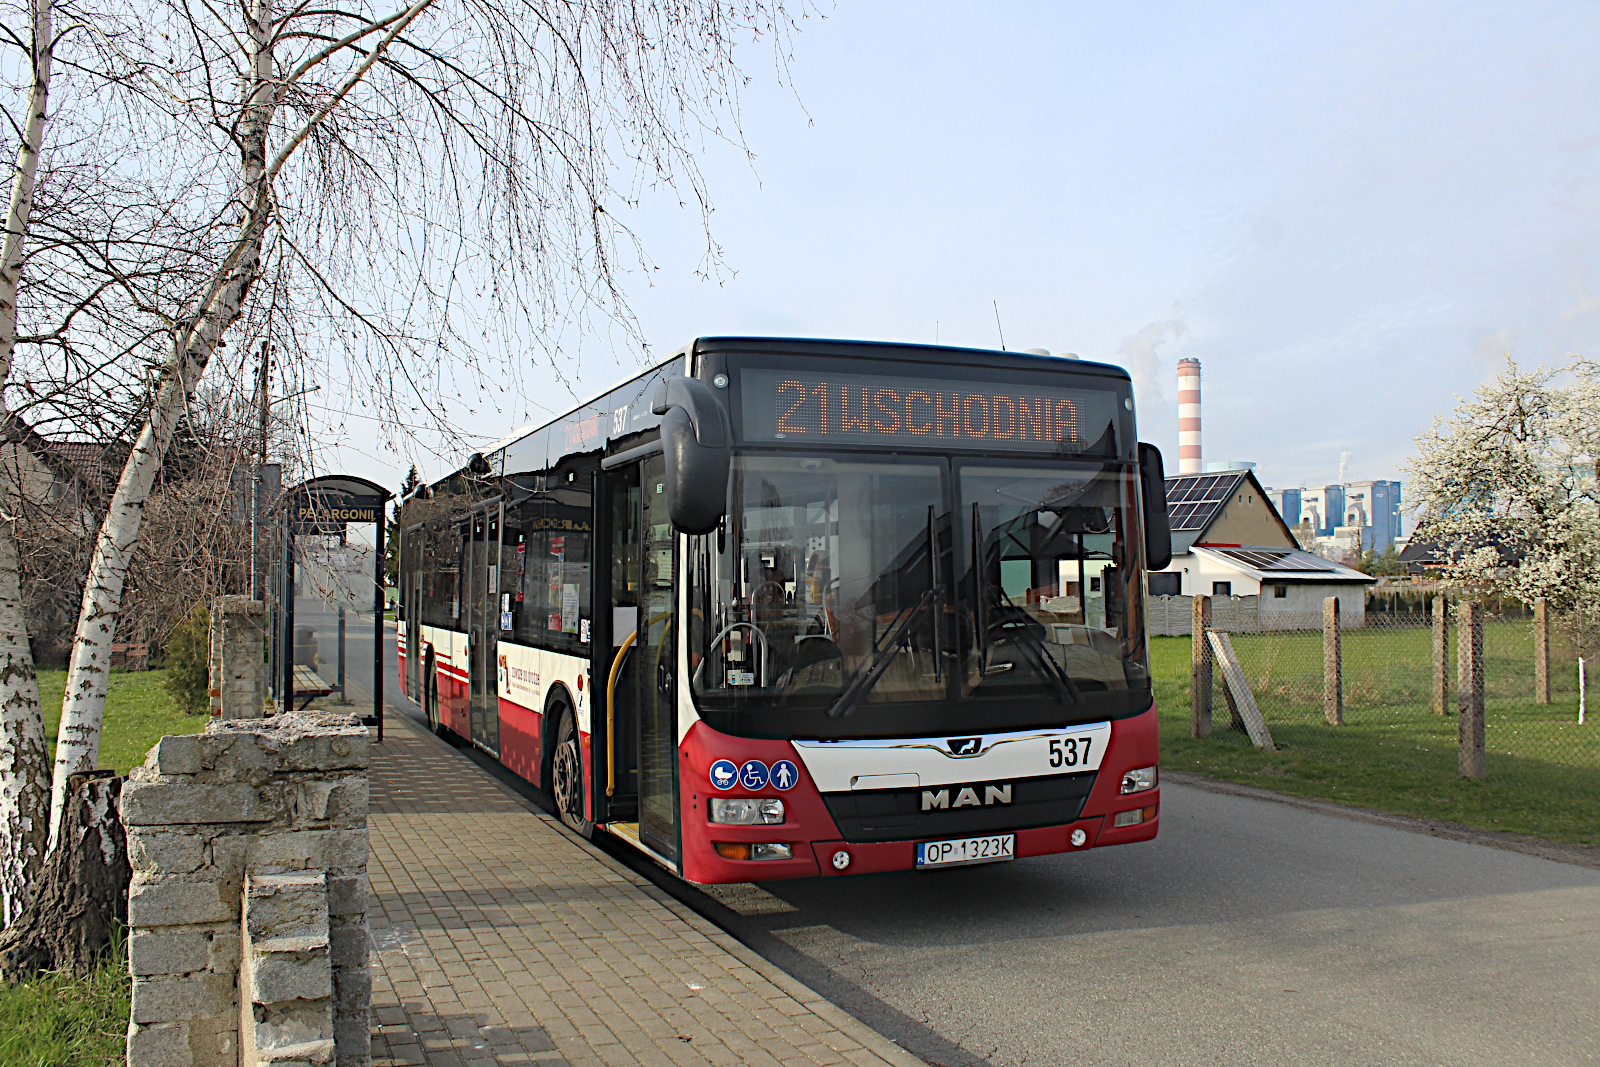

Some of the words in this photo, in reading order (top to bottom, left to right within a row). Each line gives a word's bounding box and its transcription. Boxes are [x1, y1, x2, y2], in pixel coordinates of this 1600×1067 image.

[613, 405, 628, 434] 537
[778, 380, 827, 434] 21
[842, 387, 1077, 442] WSCHODNIA
[1049, 737, 1092, 768] 537
[921, 784, 1012, 811] MAN
[927, 843, 952, 862] OP
[961, 836, 1011, 859] 1323K
